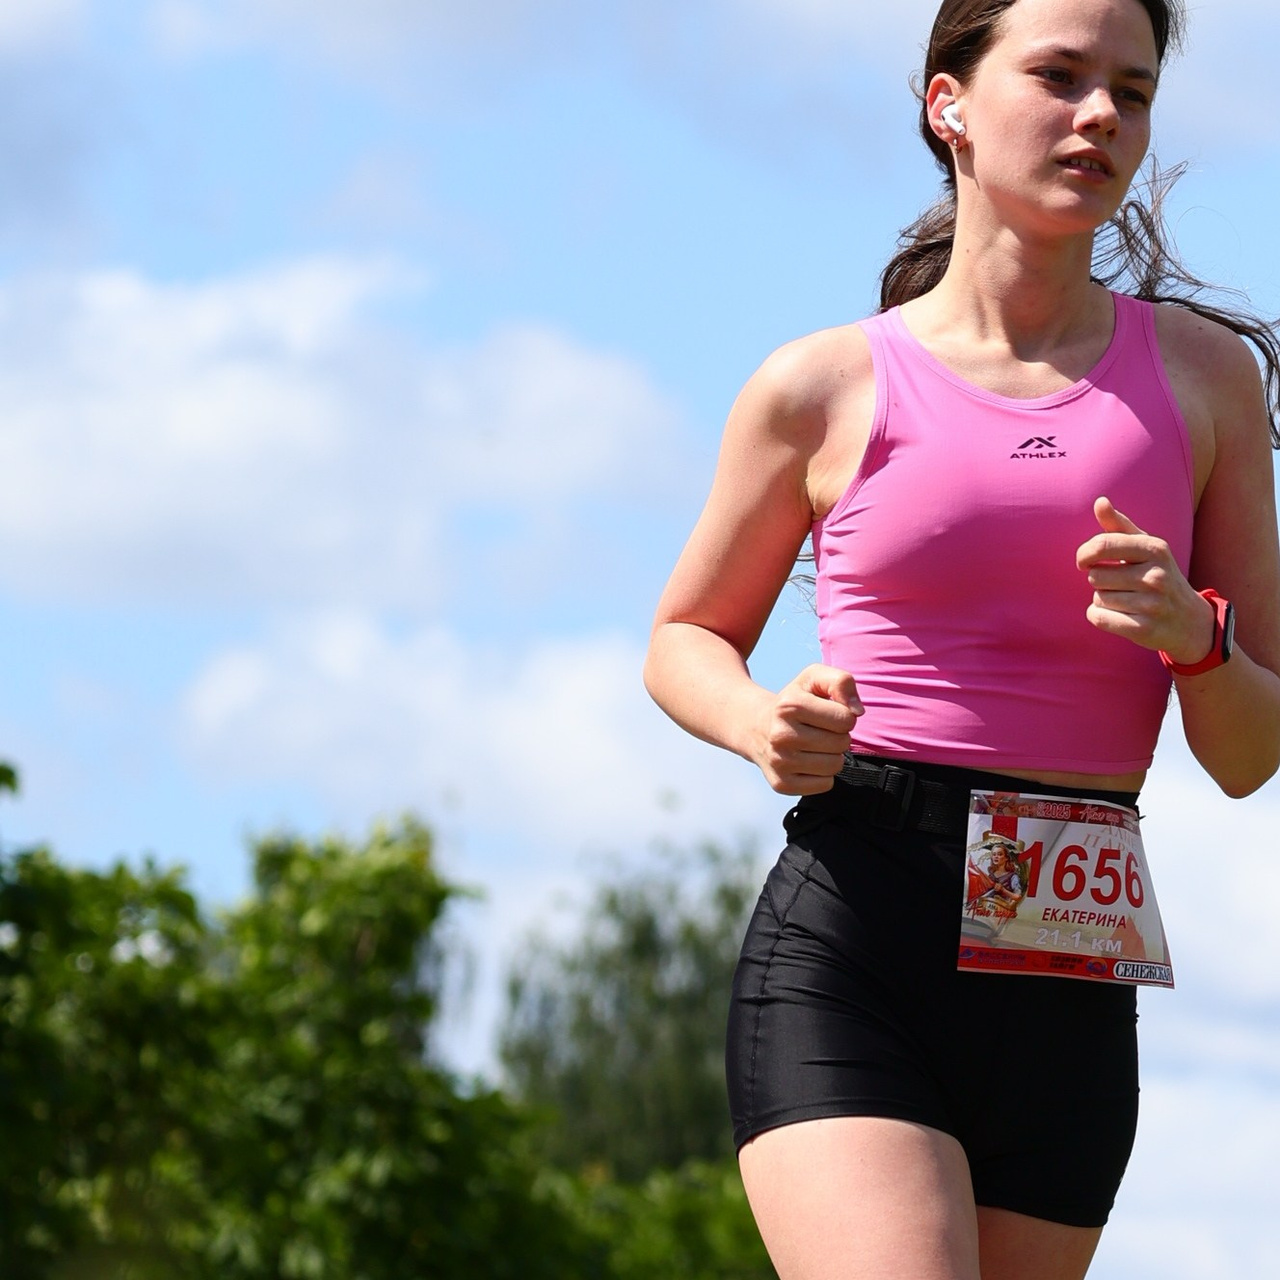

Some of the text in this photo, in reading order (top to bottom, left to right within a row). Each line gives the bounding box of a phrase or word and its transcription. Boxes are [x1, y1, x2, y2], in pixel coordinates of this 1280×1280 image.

[1010, 451, 1067, 459] ATHLEX
[1044, 802, 1071, 819] 2025
[1018, 840, 1144, 908] 1656
[1041, 907, 1127, 928] ЕКАТЕРИНА
[1034, 928, 1082, 948] 21.1
[1115, 962, 1172, 981] СЕНЕЖСКАЯ
